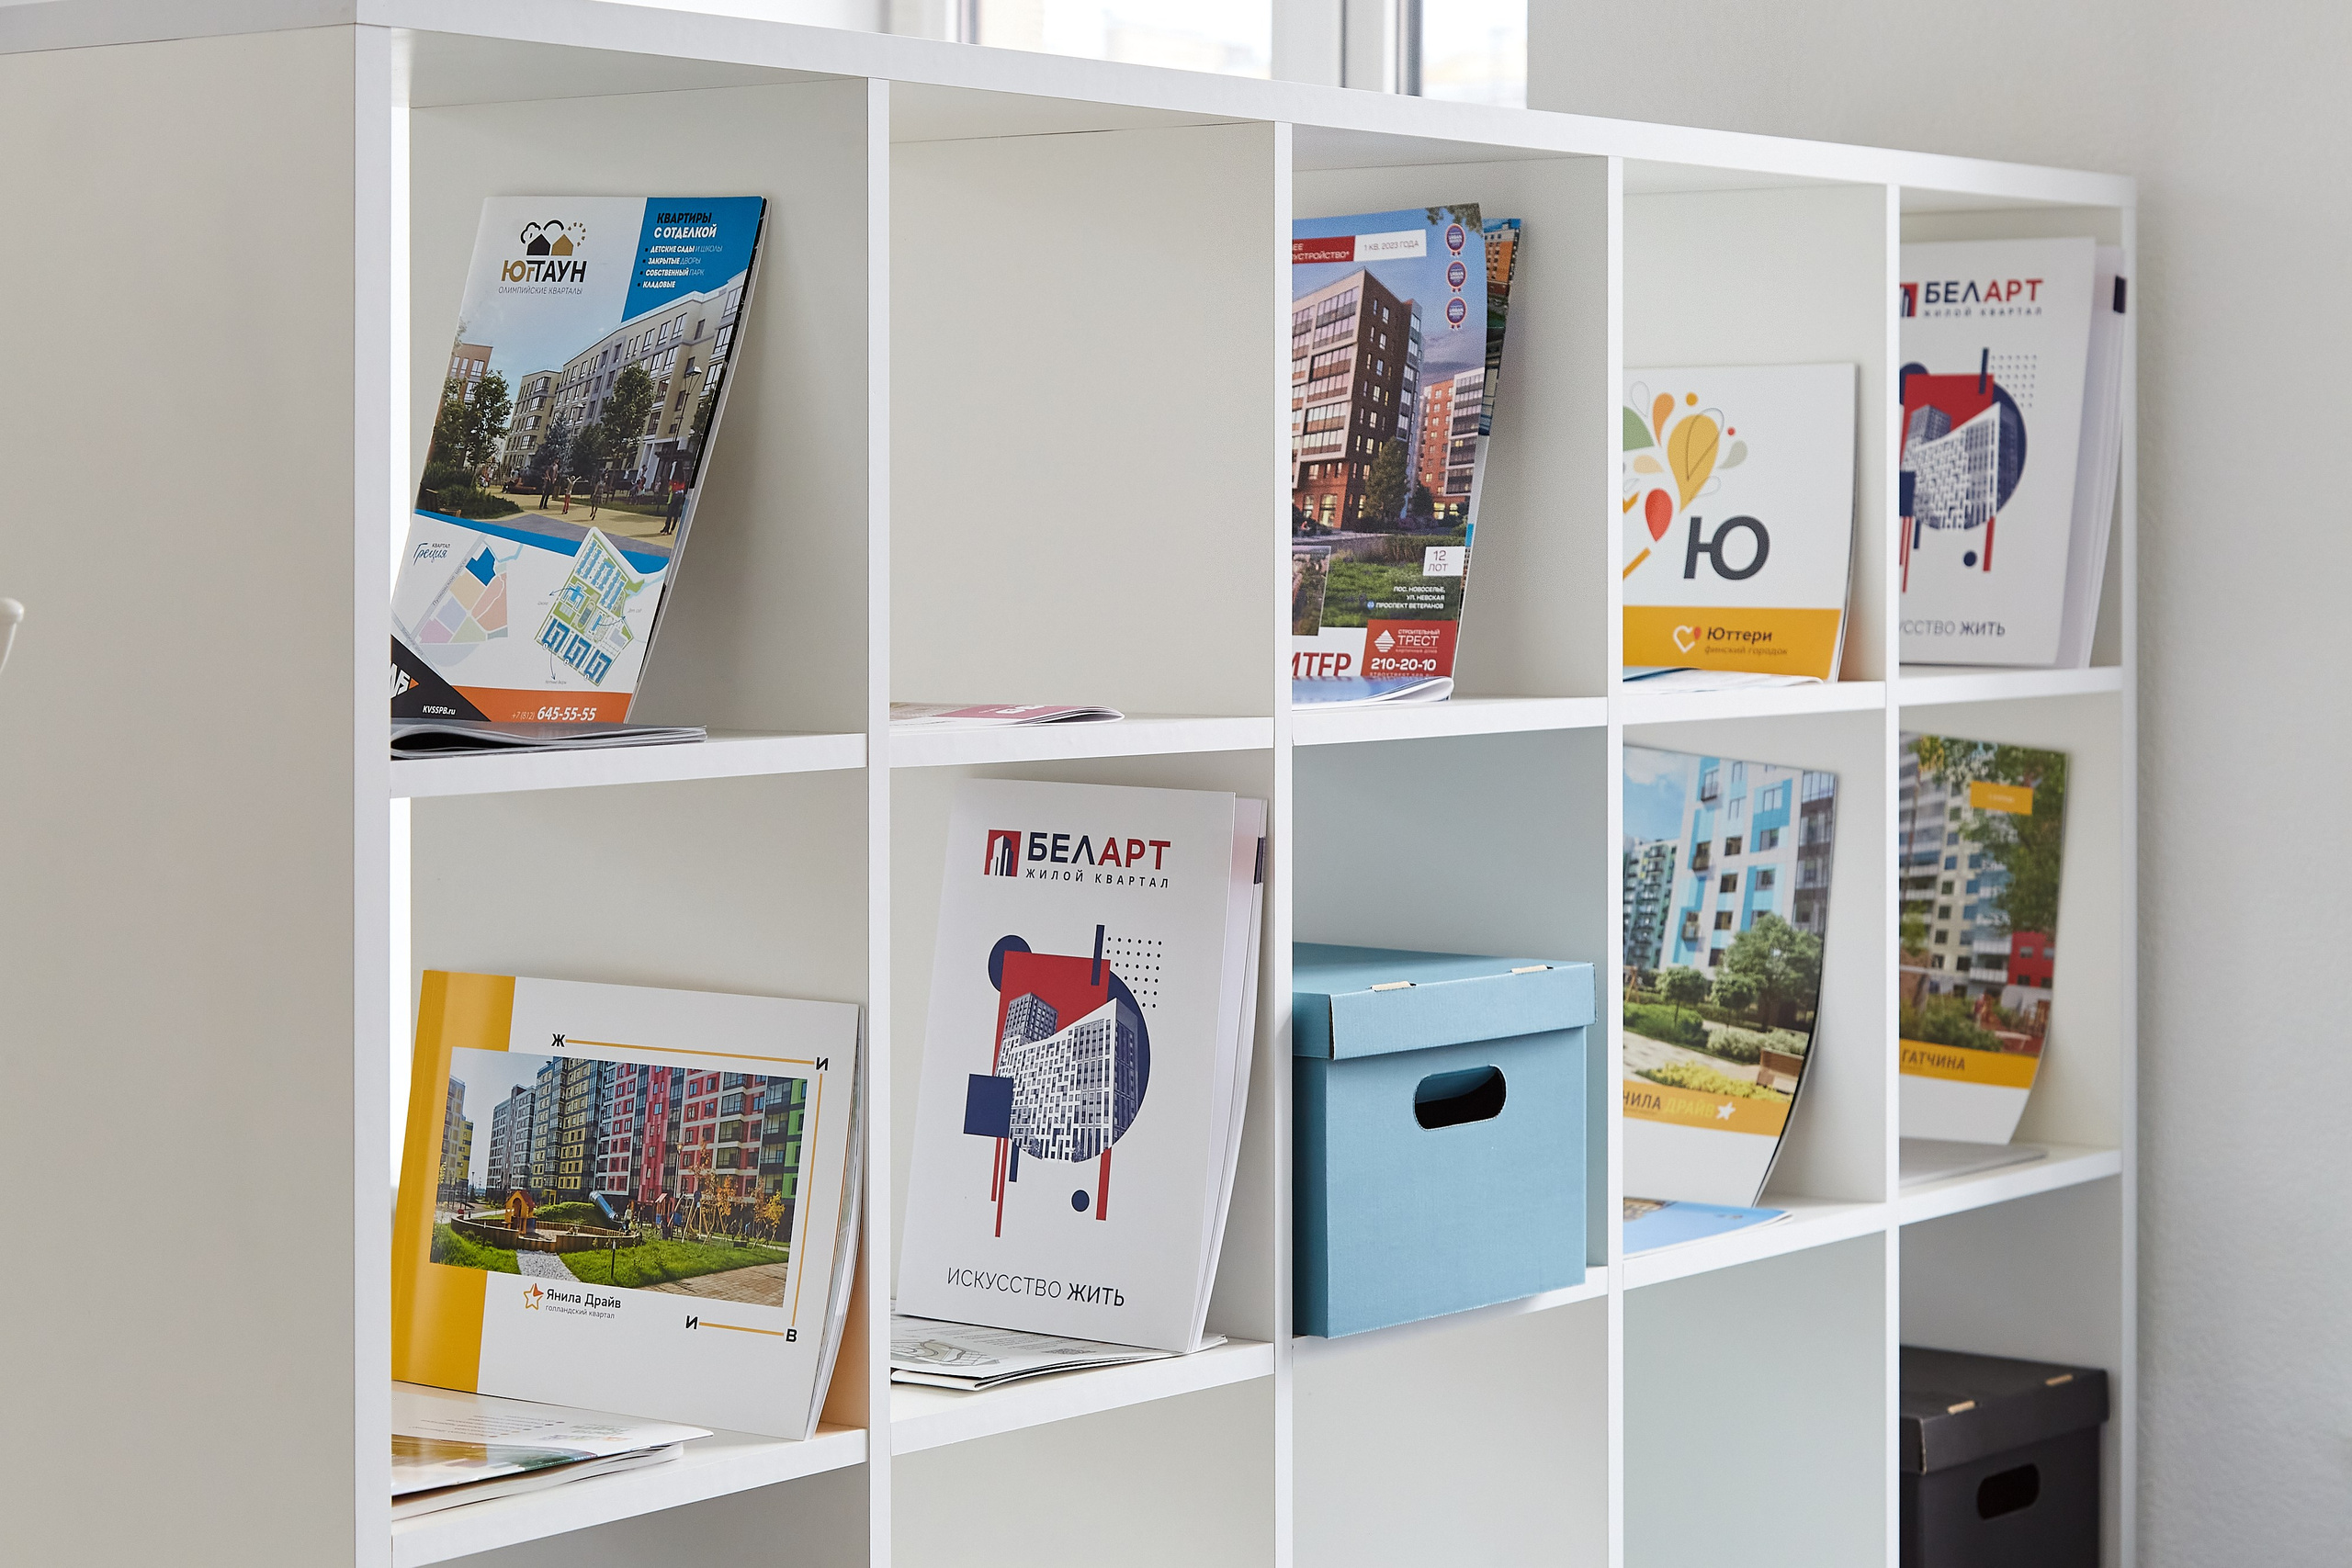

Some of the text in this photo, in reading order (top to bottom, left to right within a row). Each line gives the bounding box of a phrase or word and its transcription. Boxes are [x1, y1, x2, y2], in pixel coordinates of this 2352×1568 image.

[657, 212, 712, 224] КВАРТИРЫ
[653, 223, 717, 240] С ОТДЕЛКОЙ
[650, 245, 676, 254] ДЕТСКИЕ
[676, 245, 695, 254] САДЫ
[1381, 242, 1398, 250] 2023
[1399, 240, 1419, 248] ГОДА
[645, 267, 689, 276] СОБСТВЕННЫЙ
[498, 286, 582, 295] ОЛИМПИЙСКИЕ КВАРТАЛЫ
[1924, 279, 2043, 303] БЕЛАРТ
[1924, 306, 2042, 317] ЖИЛОЙ КВАРТАЛ
[413, 542, 447, 566] Греция
[1433, 550, 1446, 560] 12
[1683, 515, 1770, 581] Ю
[1707, 626, 1772, 645] Юттери
[1959, 621, 2006, 637] ЖИТЬ
[1397, 635, 1440, 646] ТРЕСТ
[1371, 658, 1436, 671] 210-20-10
[422, 705, 456, 715] KVSSPB.ru
[512, 706, 597, 721] +7 (812) 645-55-55
[1027, 831, 1171, 870] БЕЛАРТ
[1025, 868, 1170, 889] ЖИЛОЙ КВАРТАЛ
[551, 1033, 565, 1047] Ж
[816, 1056, 829, 1071] И
[1902, 1048, 1965, 1070] ГАТЧИНА
[1665, 1097, 1716, 1118] ДРАЙВ
[946, 1267, 1125, 1307] ИСКУССТВО ЖИТЬ
[547, 1289, 621, 1309] Янила Драйв
[545, 1305, 615, 1319] голландский квартал
[685, 1315, 698, 1330] И
[786, 1328, 797, 1342] В
